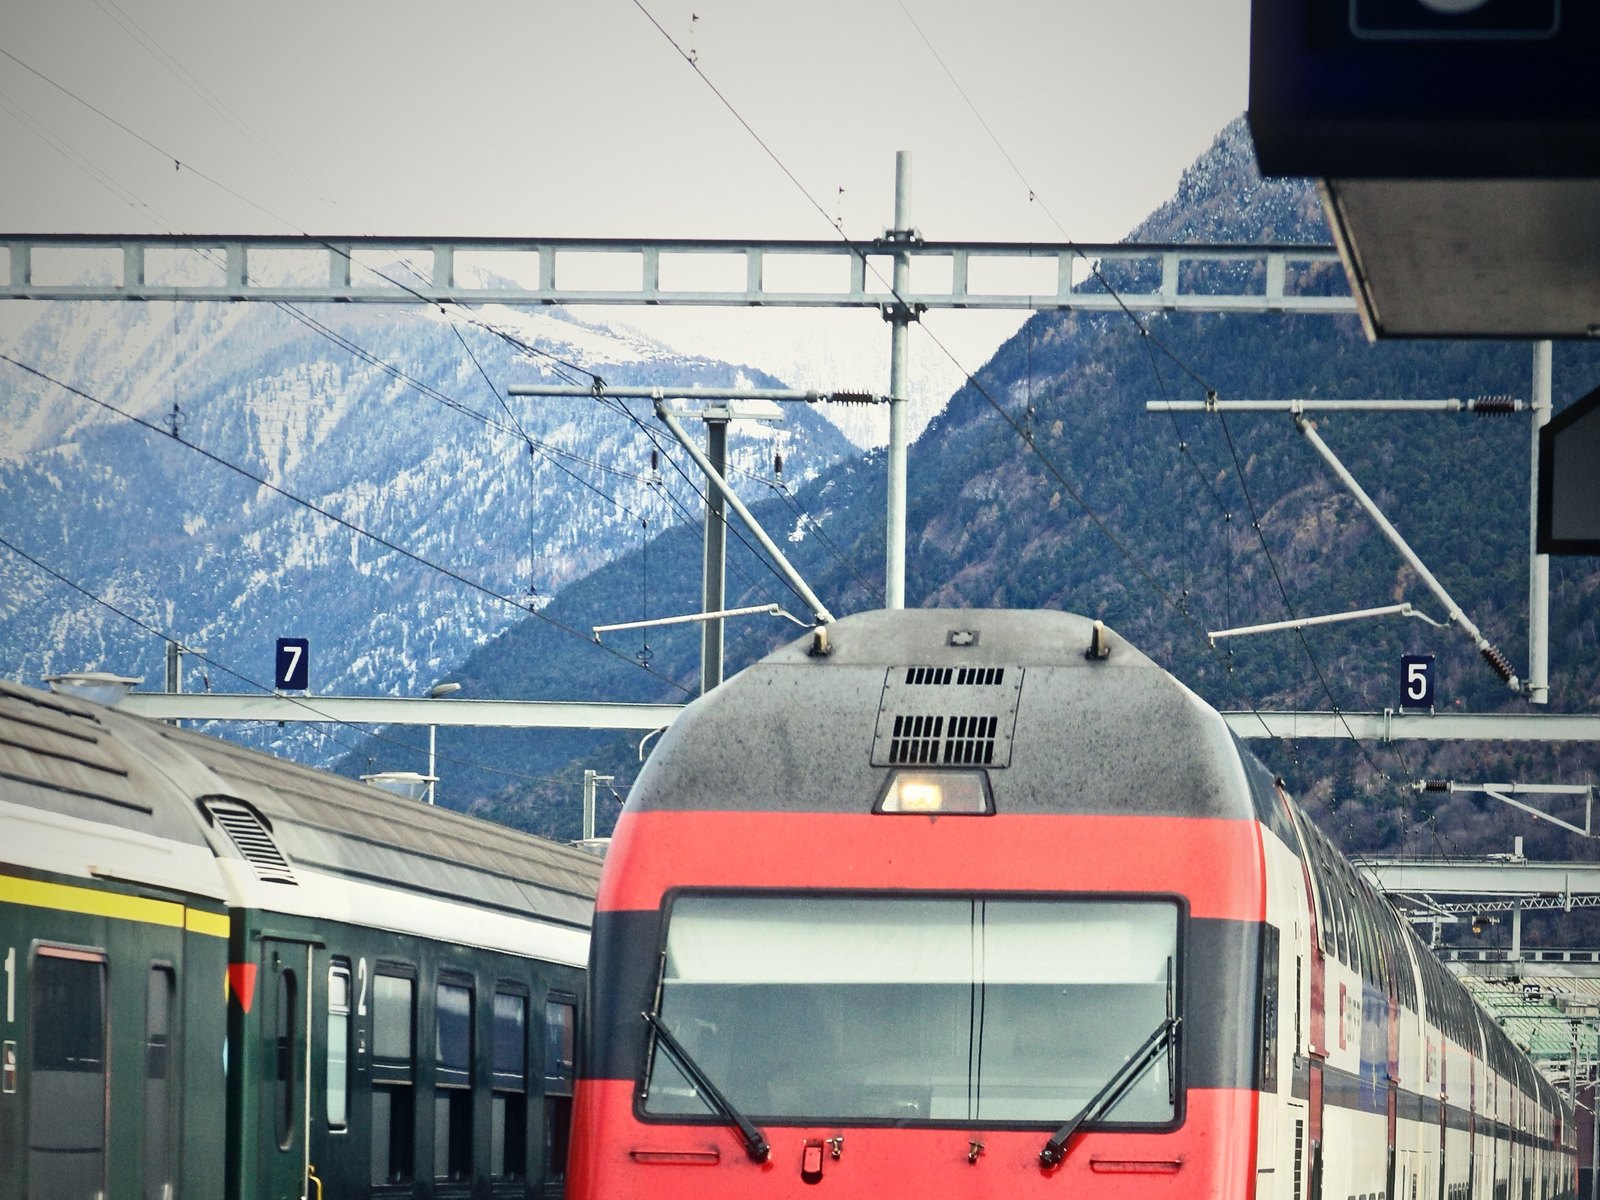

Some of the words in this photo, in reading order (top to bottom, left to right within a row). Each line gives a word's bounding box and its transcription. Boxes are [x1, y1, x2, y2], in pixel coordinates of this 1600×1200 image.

[283, 646, 302, 682] 7
[1408, 663, 1427, 700] 5
[4, 947, 15, 1023] 1
[358, 957, 368, 1016] 2
